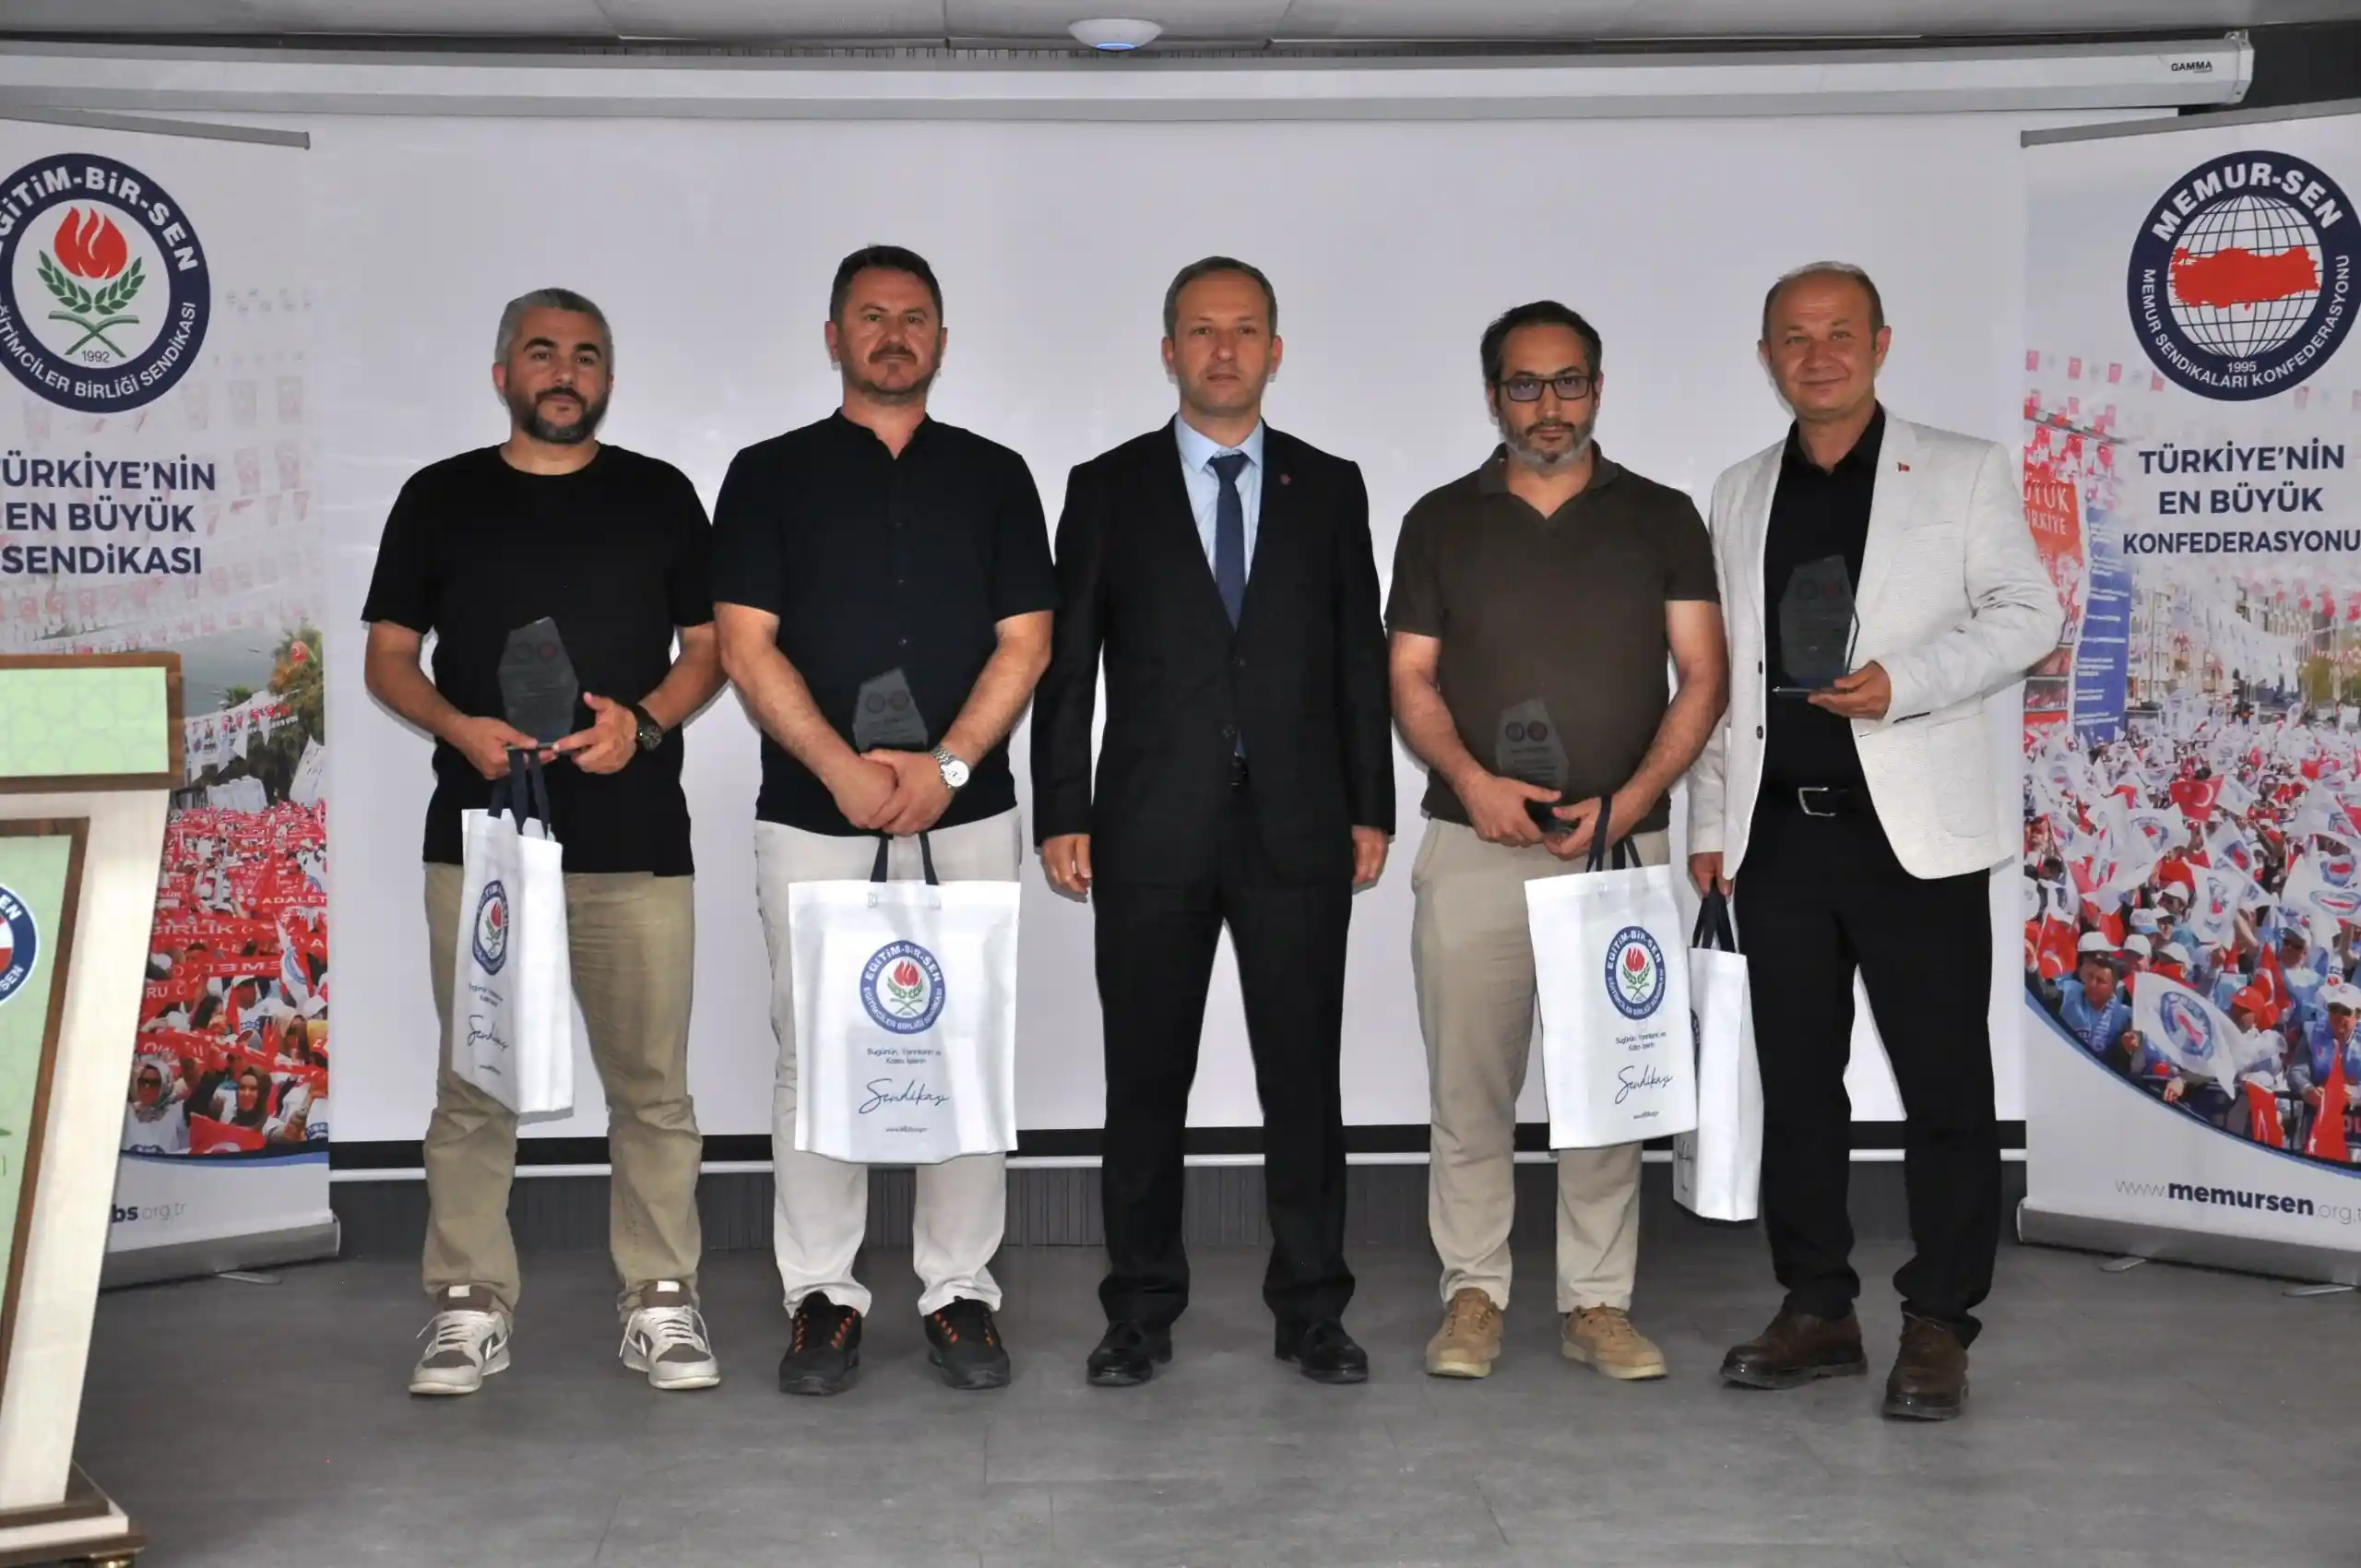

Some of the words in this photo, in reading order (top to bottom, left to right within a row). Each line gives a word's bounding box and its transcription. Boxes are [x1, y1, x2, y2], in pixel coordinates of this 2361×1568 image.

[2171, 61, 2213, 72] GAMMA
[2152, 162, 2343, 243] MEMUR-SEN
[2142, 268, 2163, 334] MEMUR
[2155, 333, 2248, 388] SENDİKALARI
[2252, 255, 2350, 388] KONFEDERASYONU
[75, 374, 139, 399] BİRLİĞİ
[140, 302, 196, 387] SENDİKASI
[81, 350, 111, 362] 1992
[2227, 361, 2257, 374] 1995
[2, 450, 216, 491] ÜRKİYE'NİN
[2139, 437, 2344, 474] TÜRKİYE'NİN
[6, 503, 57, 531] EN
[68, 494, 196, 532] BÜYÜK
[2159, 491, 2201, 515] EN
[2211, 481, 2324, 514] BÜYÜK
[1, 542, 201, 575] SENDİKASI
[2123, 529, 2361, 554] KONFEDERASYONU
[262, 896, 326, 905] ADALET
[2115, 1181, 2361, 1225] www.memursen.org.t
